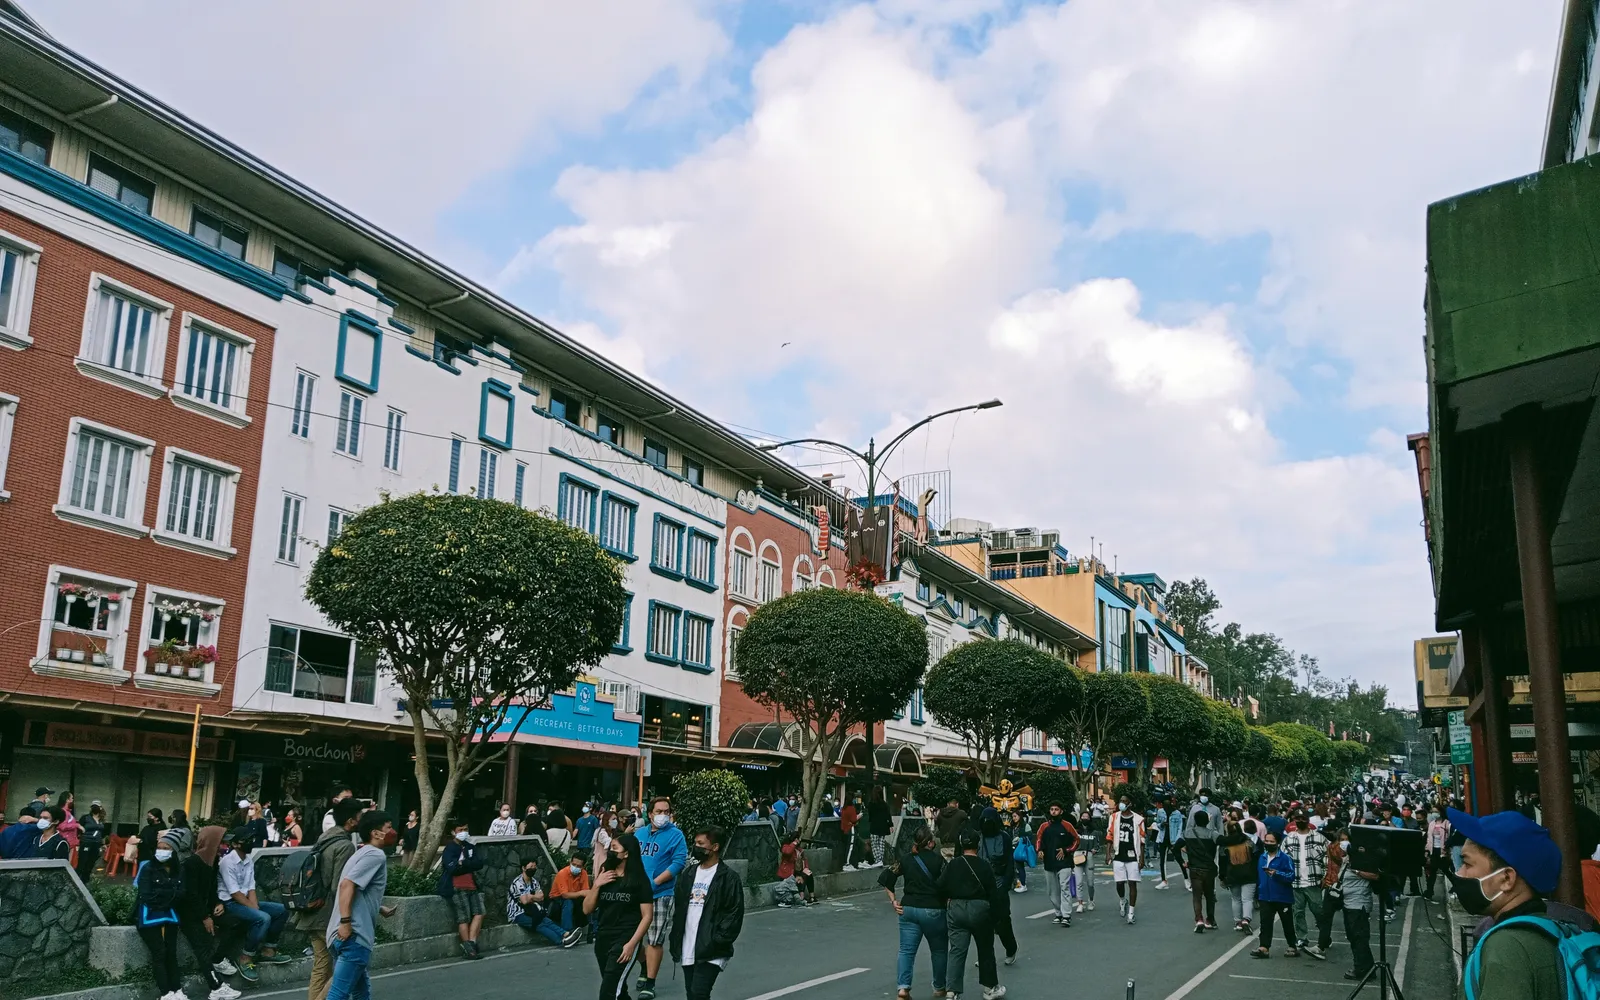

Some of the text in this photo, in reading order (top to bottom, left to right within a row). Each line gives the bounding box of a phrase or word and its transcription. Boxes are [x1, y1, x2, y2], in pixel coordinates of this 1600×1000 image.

[578, 704, 590, 713] Globe
[1449, 712, 1457, 725] 3
[534, 717, 624, 738] RECREATE. BETTER DAYS
[283, 738, 350, 762] Bonchon
